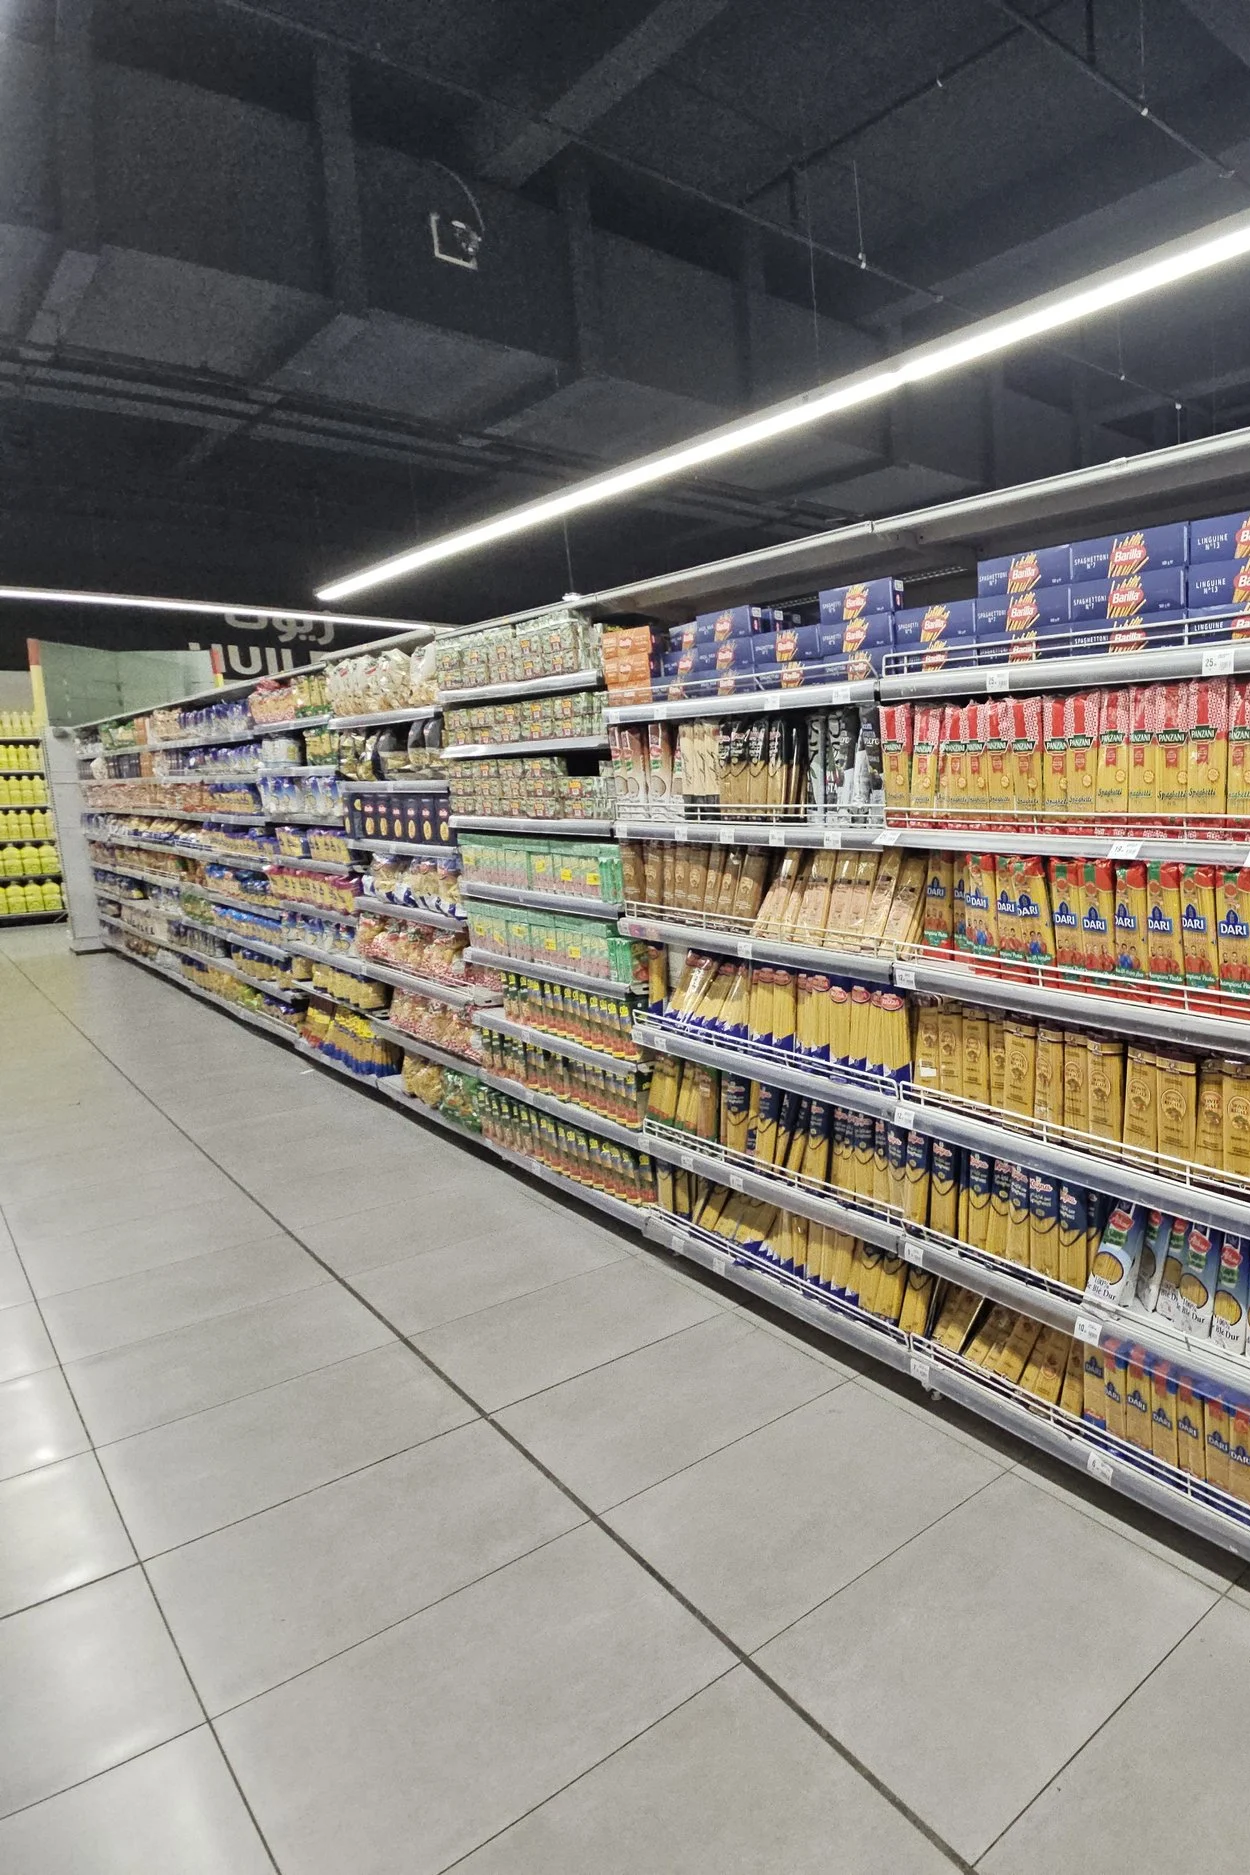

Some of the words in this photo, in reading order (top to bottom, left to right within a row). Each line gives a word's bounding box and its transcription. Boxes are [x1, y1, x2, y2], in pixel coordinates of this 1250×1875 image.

[1114, 548, 1144, 561] Barilla
[1159, 731, 1185, 743] PANZANI
[1190, 729, 1215, 740] PANZANI
[1083, 918, 1106, 931] DARI
[1220, 923, 1247, 935] DARI
